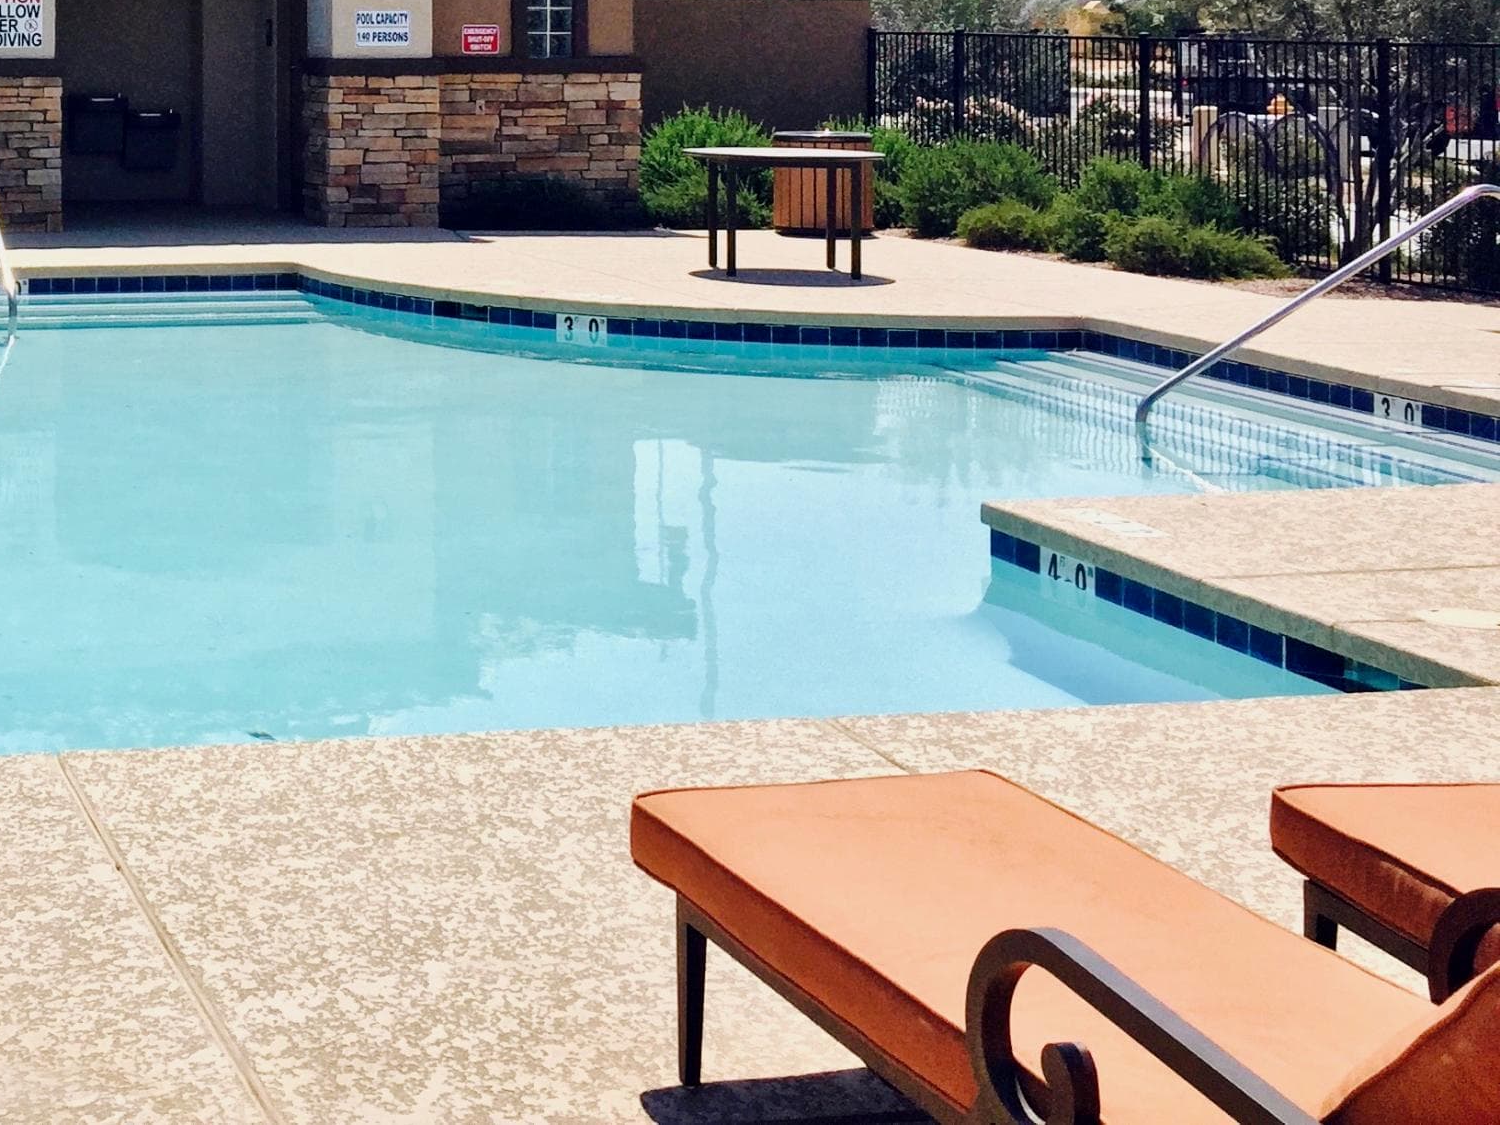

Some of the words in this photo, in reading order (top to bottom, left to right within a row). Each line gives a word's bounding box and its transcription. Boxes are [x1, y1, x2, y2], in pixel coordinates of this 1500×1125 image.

[356, 13, 375, 24] POOL
[376, 13, 408, 24] CAPACITY
[372, 32, 409, 42] PERSONS
[1075, 563, 1087, 590] 0
